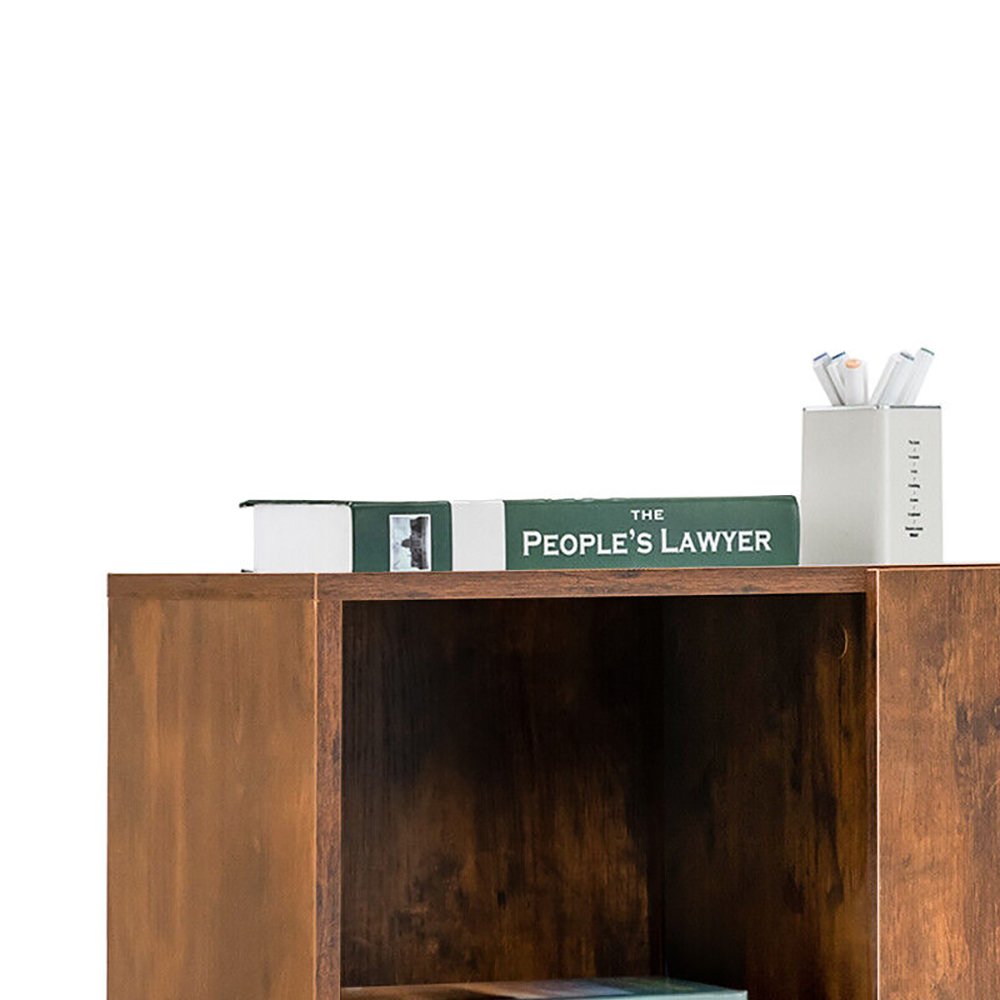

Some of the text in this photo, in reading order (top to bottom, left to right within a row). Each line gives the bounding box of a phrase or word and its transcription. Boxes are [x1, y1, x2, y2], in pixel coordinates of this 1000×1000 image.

[630, 509, 665, 521] THE
[522, 528, 772, 557] PEOPLE'S LAWYER
